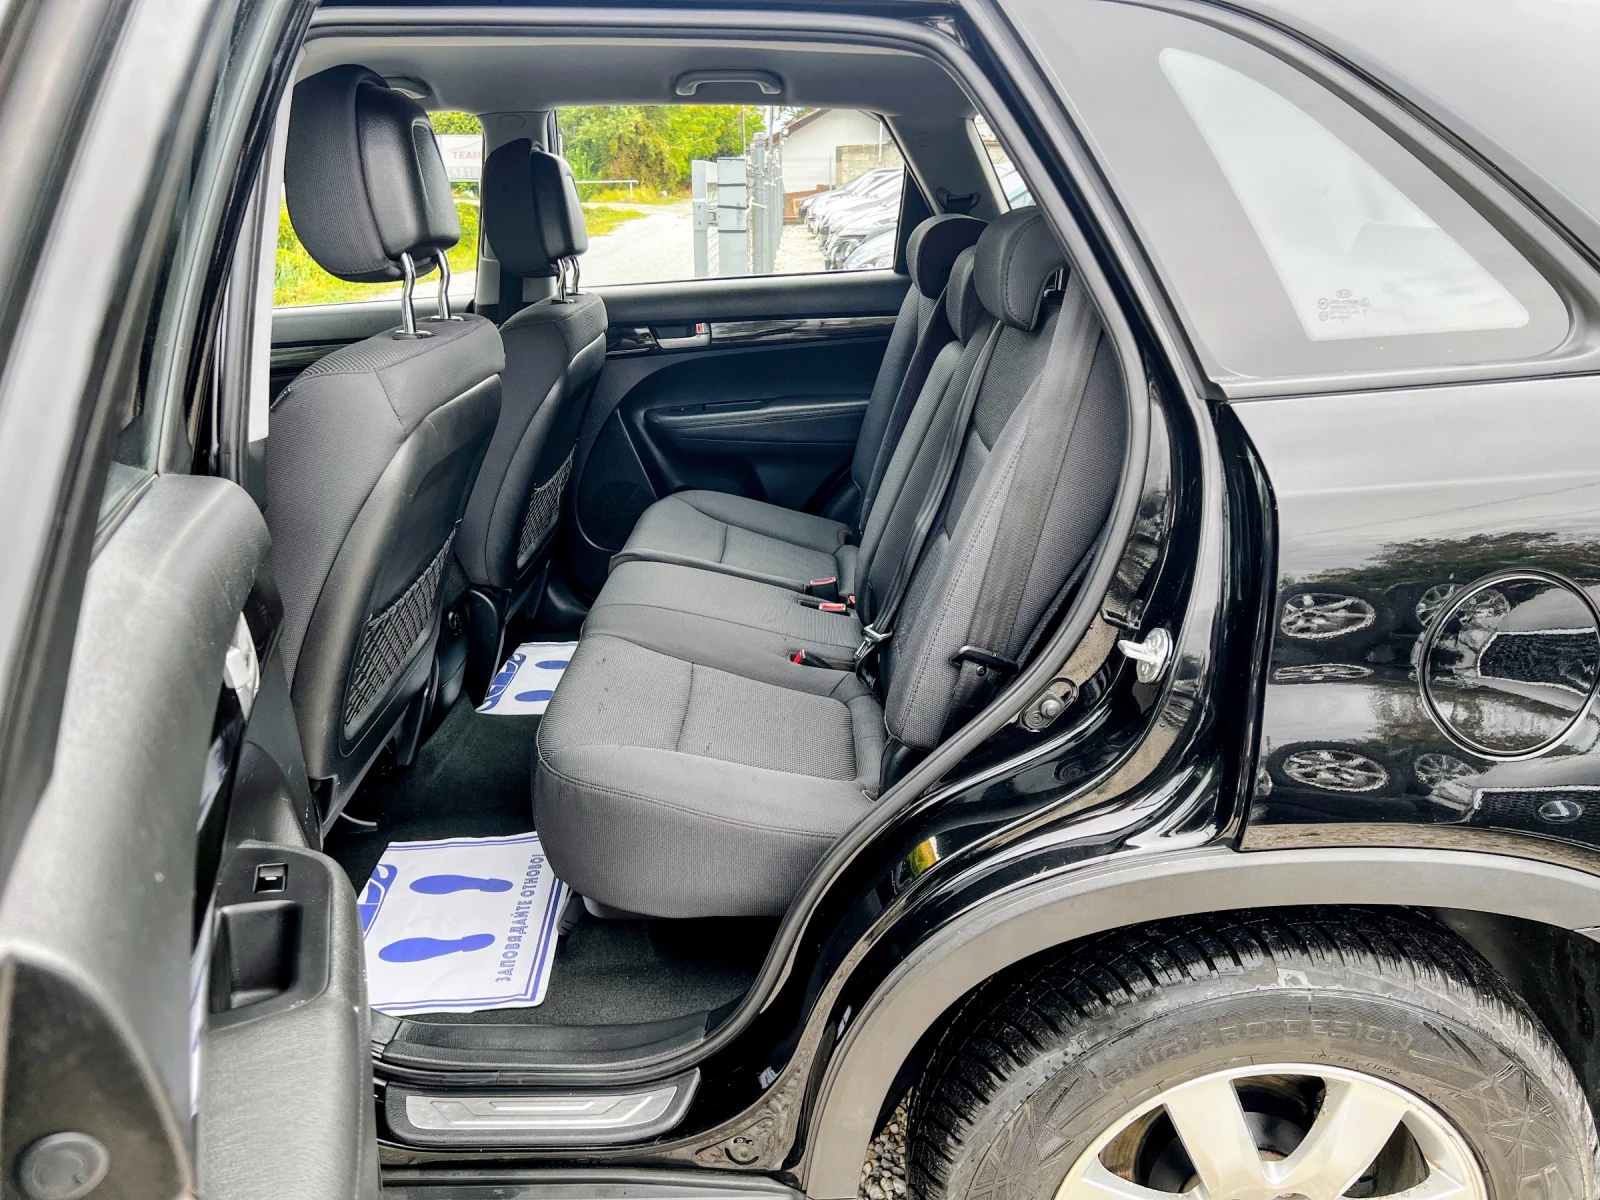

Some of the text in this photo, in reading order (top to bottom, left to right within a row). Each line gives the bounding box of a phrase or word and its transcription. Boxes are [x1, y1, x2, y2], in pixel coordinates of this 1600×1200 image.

[452, 151, 481, 159] TEAM
[494, 853, 545, 983] ЗАПОВЯДАЙТЕ ОТНОВО!
[1283, 1019, 1414, 1051] DESIGN
